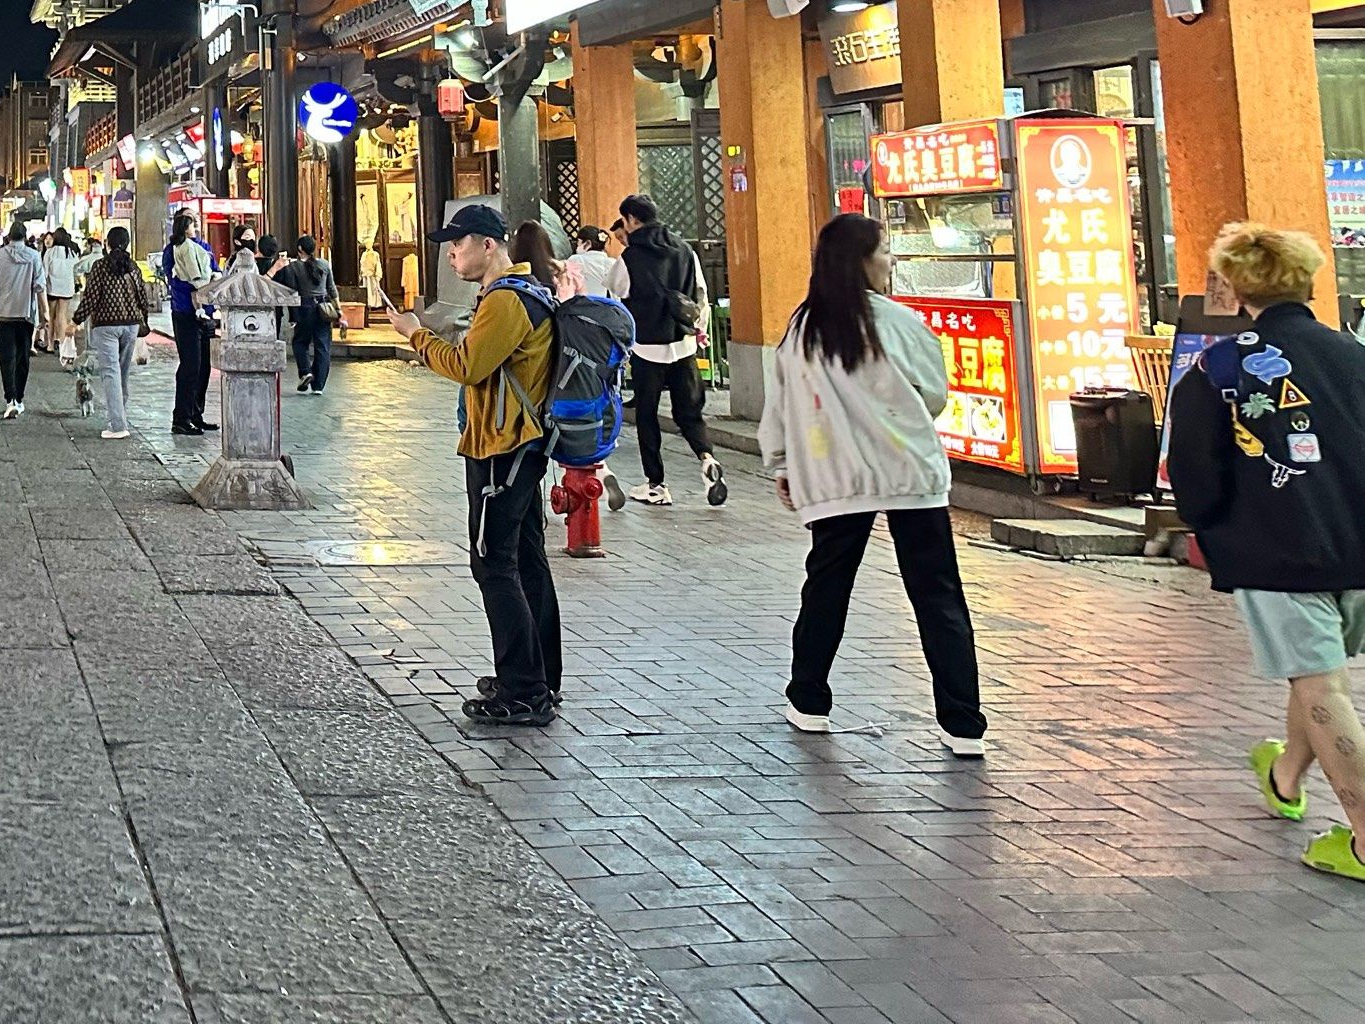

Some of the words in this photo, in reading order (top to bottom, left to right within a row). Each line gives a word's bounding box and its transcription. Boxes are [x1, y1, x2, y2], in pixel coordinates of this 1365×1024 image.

[1042, 208, 1109, 245] 尤氏
[1036, 249, 1124, 286] 臭豆腐
[1287, 390, 1297, 401] 8
